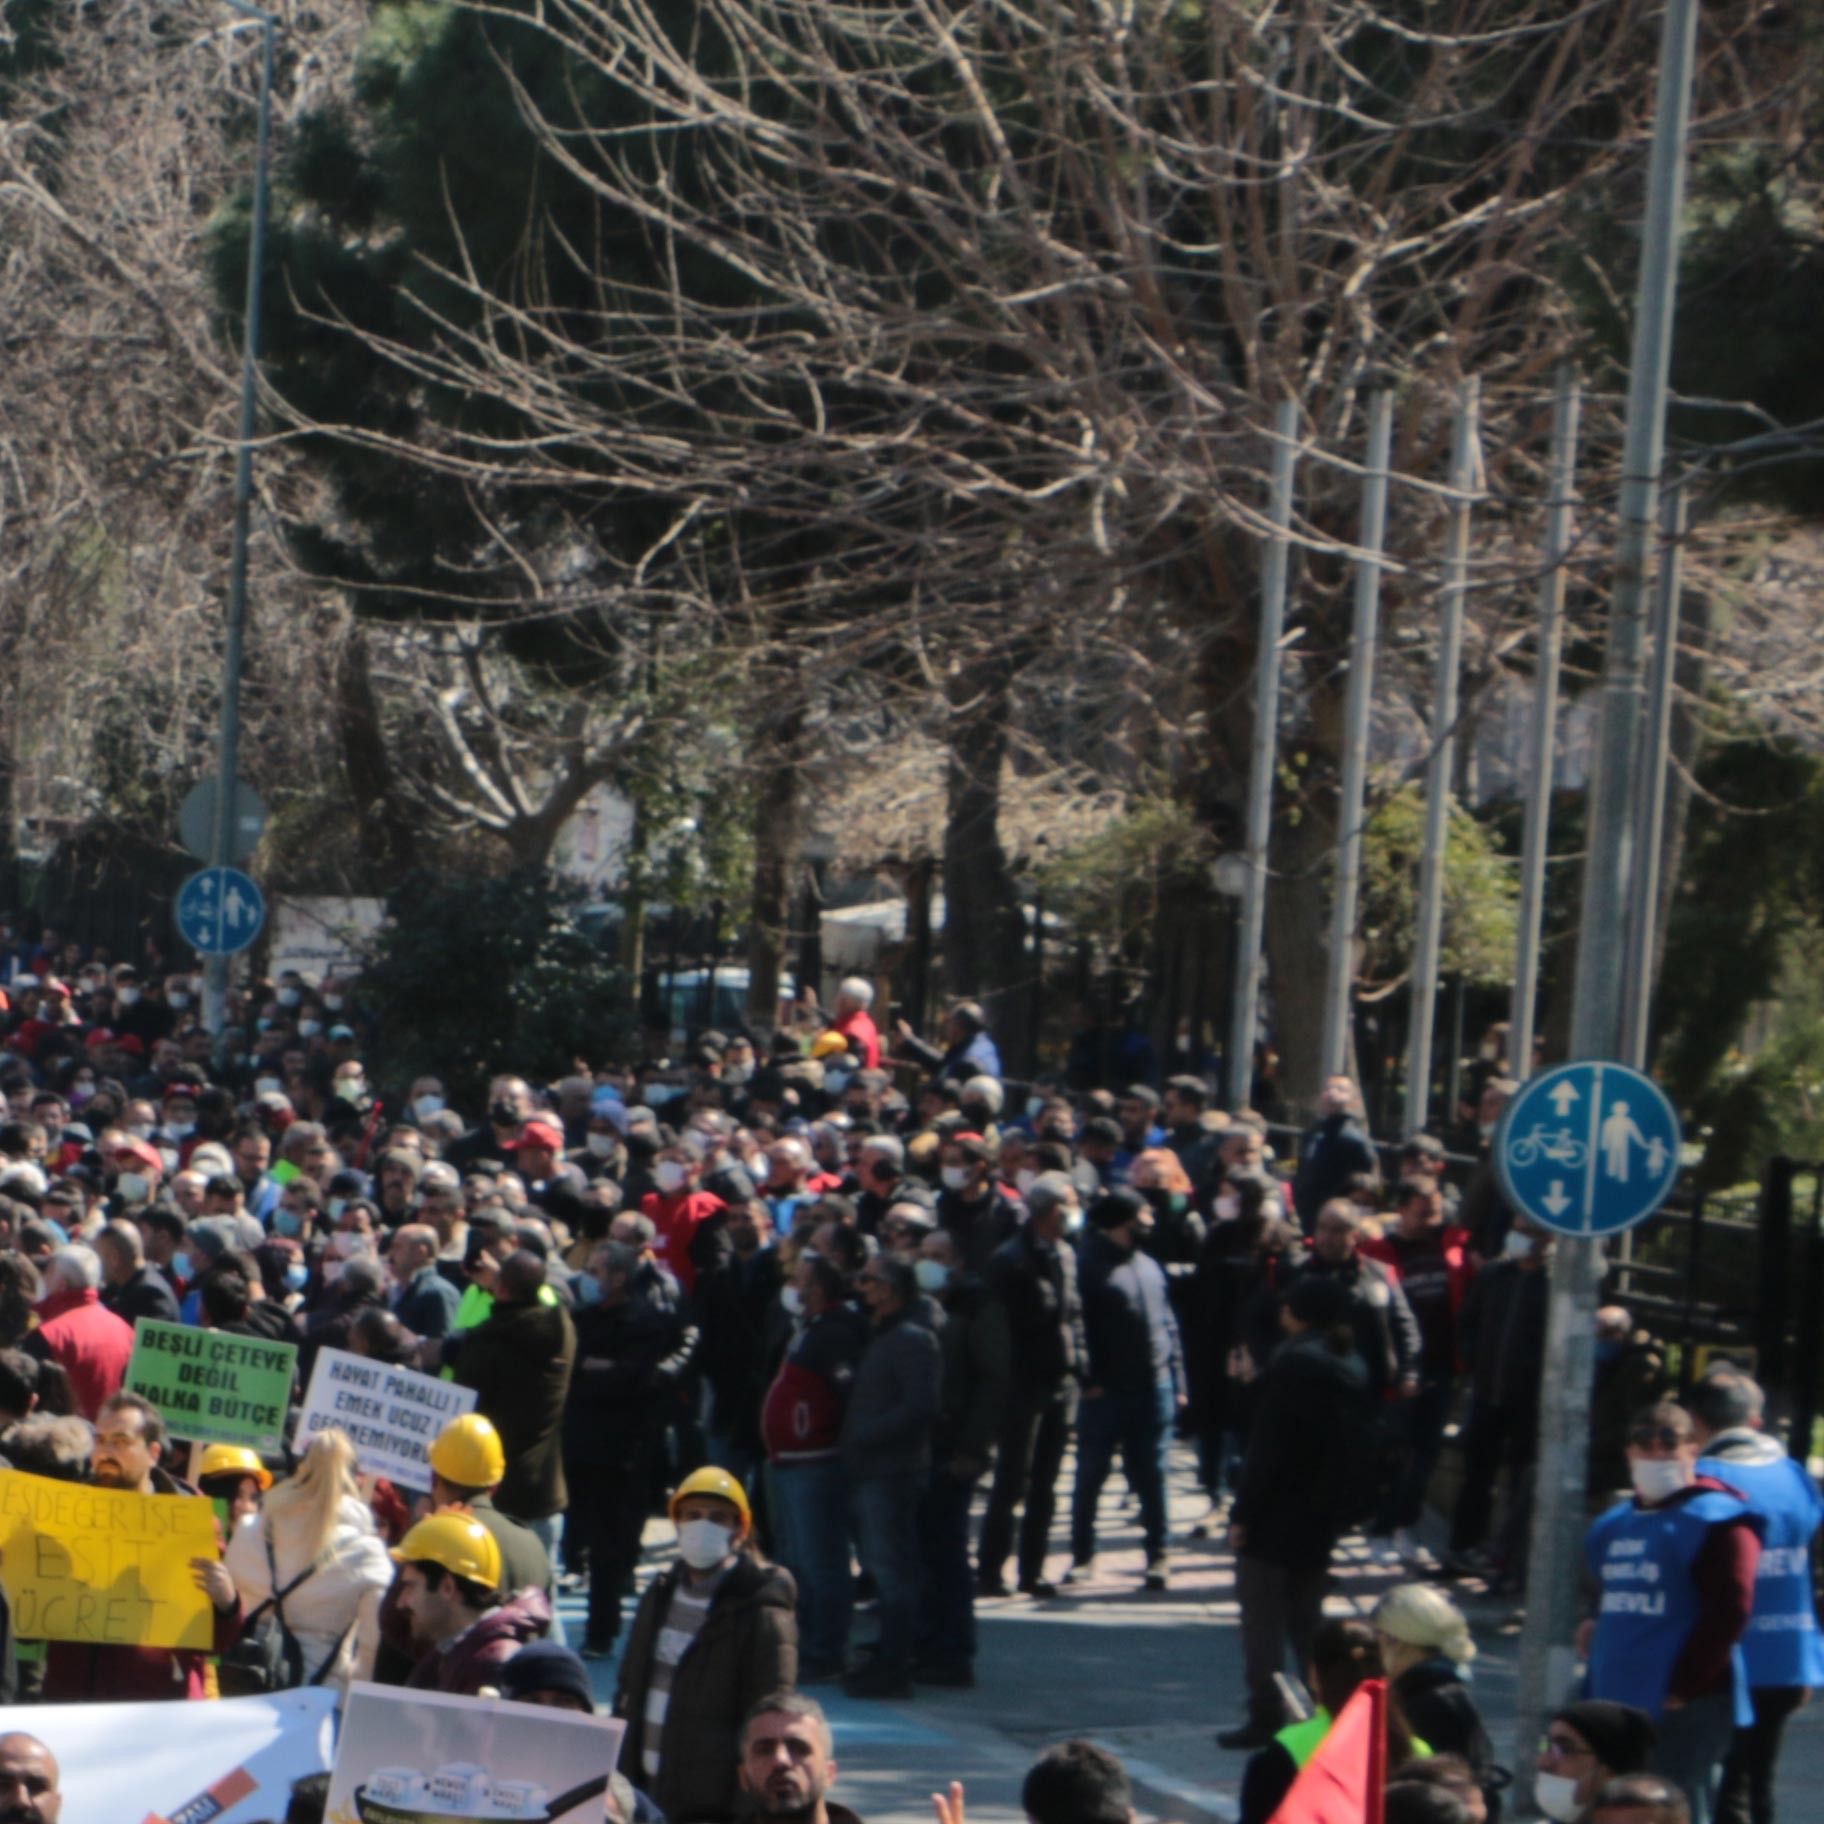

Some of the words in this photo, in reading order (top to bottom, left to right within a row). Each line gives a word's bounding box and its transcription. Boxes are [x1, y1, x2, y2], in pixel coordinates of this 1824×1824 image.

[142, 1328, 202, 1359] BEŞLİ
[178, 1360, 239, 1392] DEĞİL
[209, 1395, 280, 1427] BÜTÇE
[14, 1588, 169, 1642] ÜCRET
